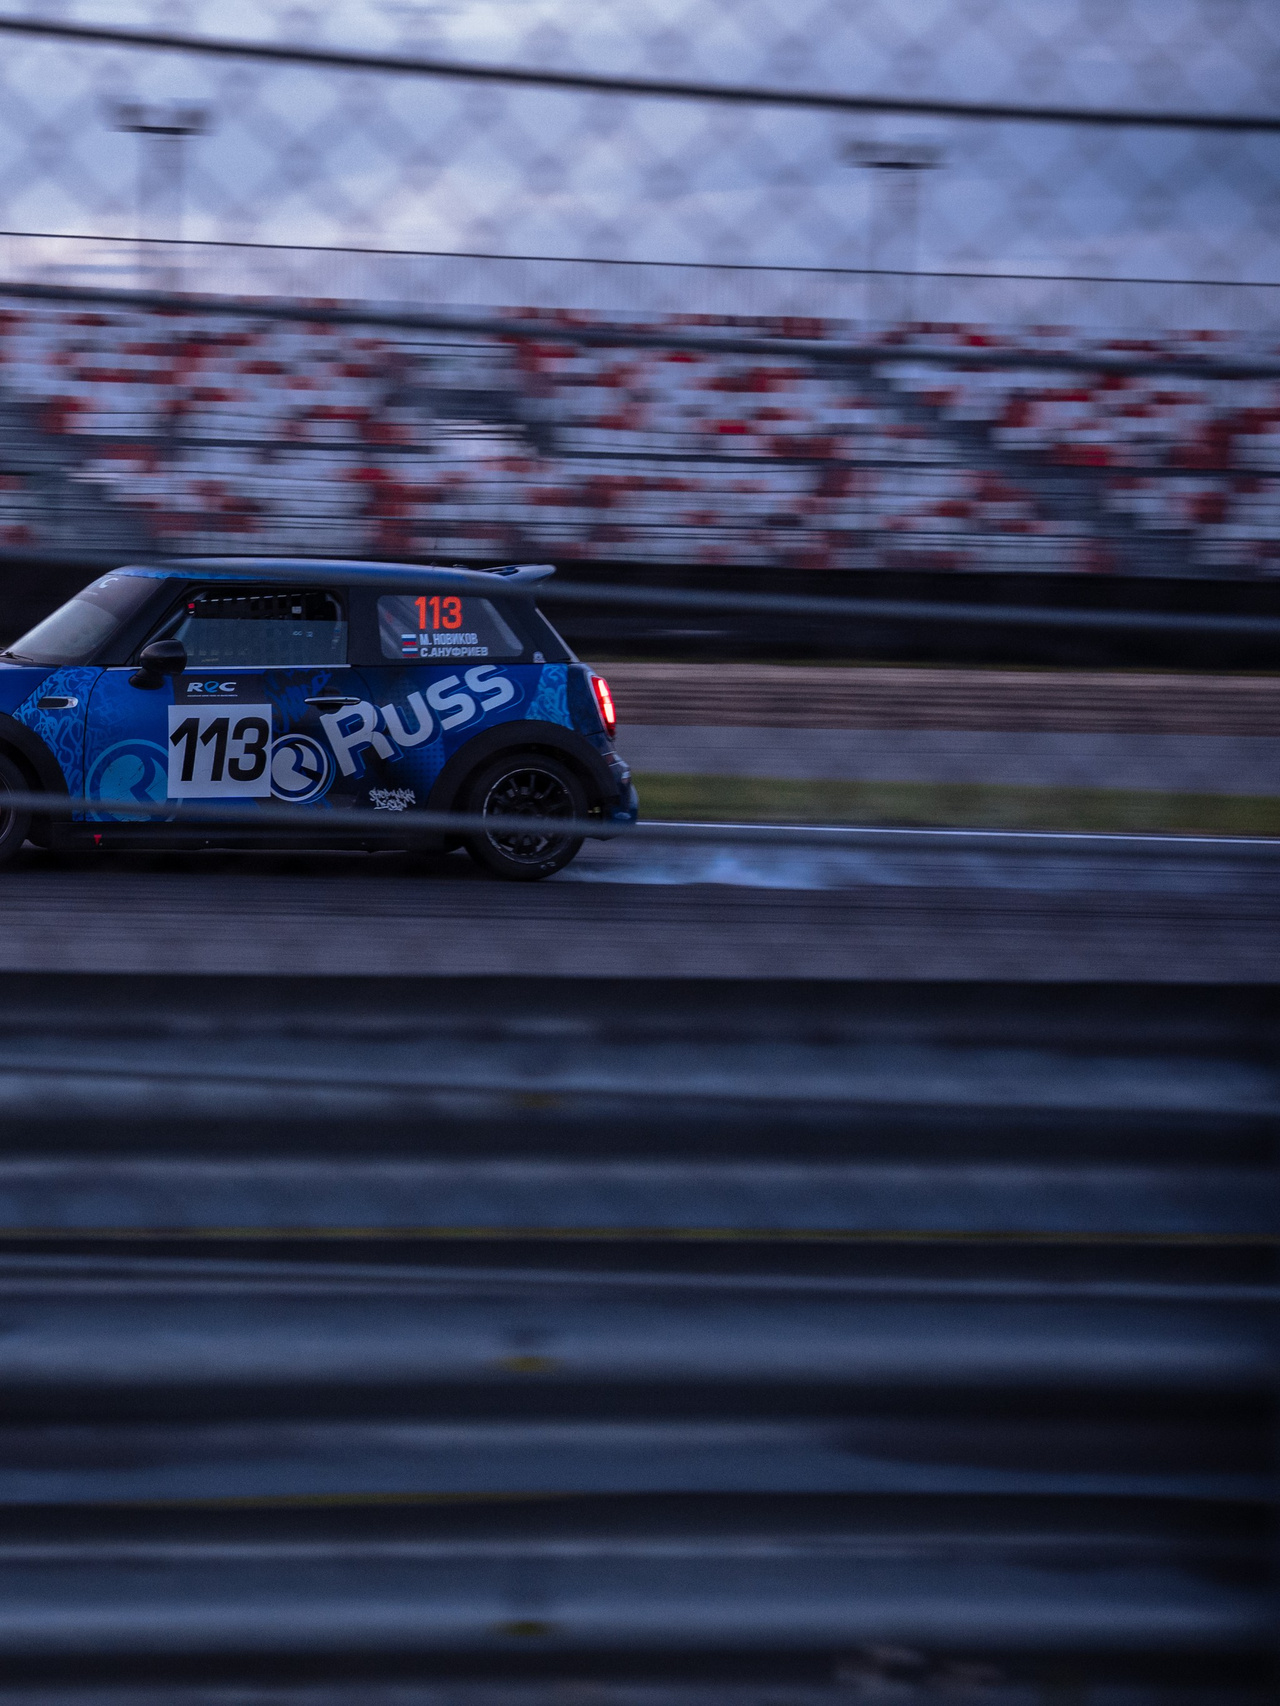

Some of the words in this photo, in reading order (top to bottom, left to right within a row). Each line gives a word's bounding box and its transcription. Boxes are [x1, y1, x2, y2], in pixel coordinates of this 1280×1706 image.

[414, 596, 462, 630] 113
[419, 634, 432, 646] М.
[432, 633, 479, 646] НОВИКОВ
[319, 664, 515, 777] RUSS
[169, 717, 270, 782] 113
